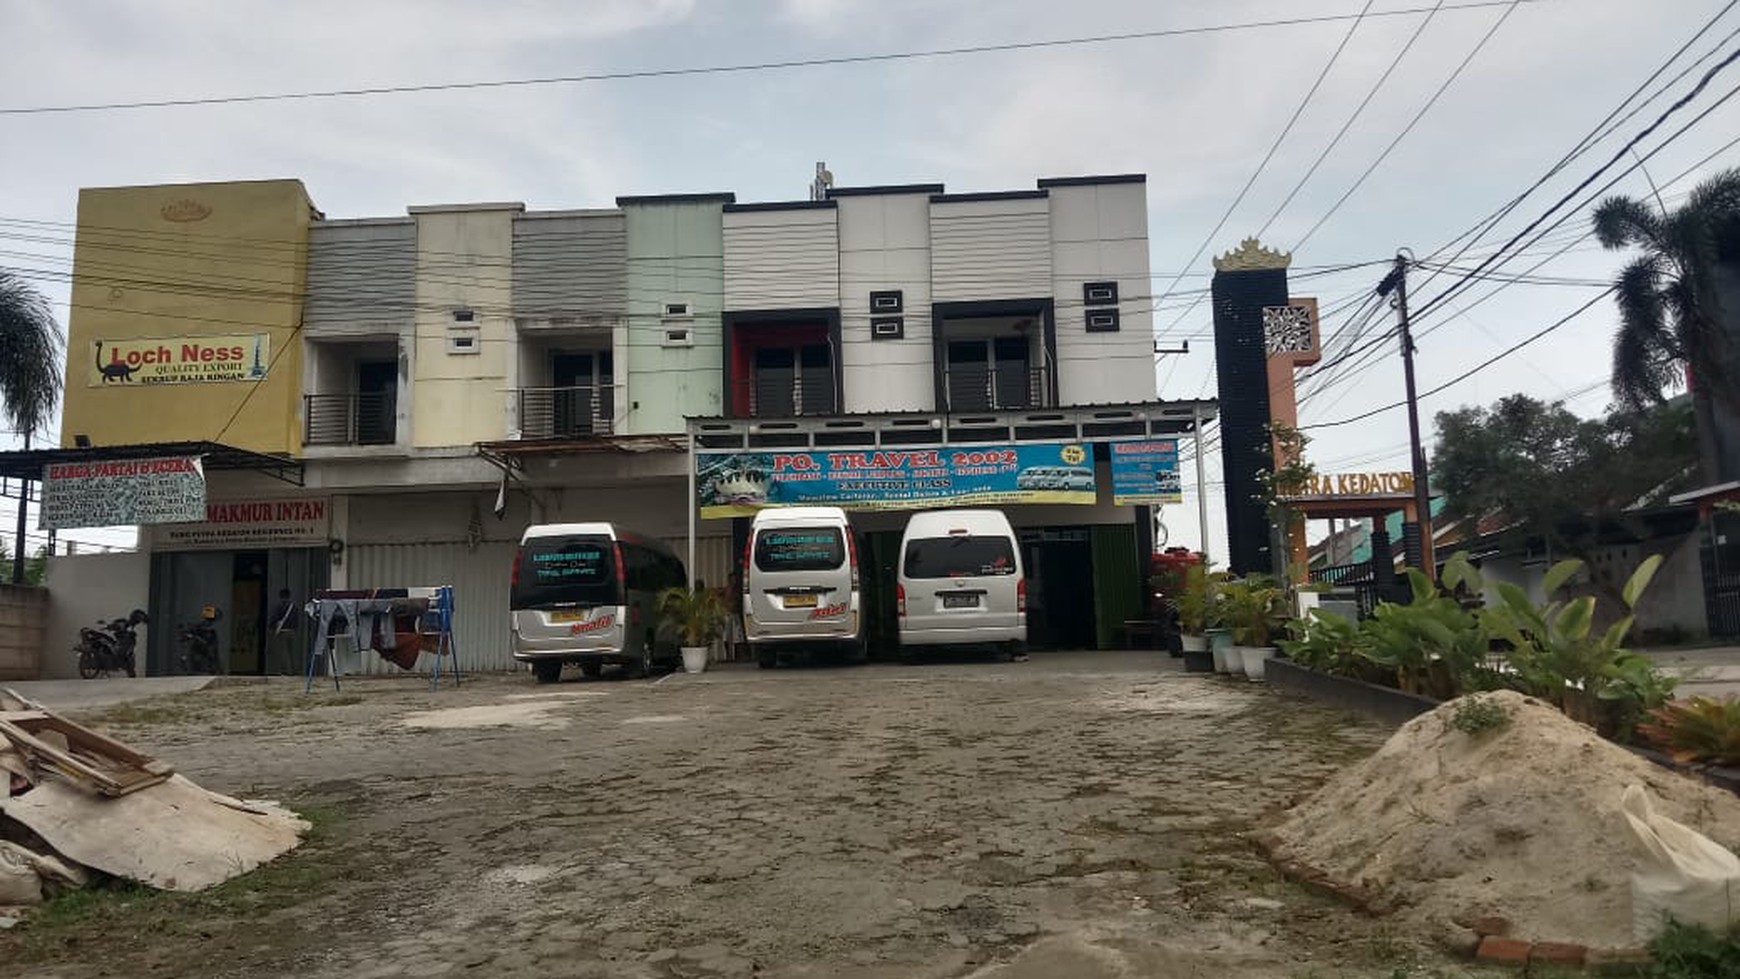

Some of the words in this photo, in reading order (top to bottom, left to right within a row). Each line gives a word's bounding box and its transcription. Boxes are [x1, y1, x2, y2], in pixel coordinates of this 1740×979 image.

[112, 346, 171, 365] Loch
[181, 345, 244, 362] Ness
[155, 364, 201, 375] QUALITY
[203, 363, 242, 373] EXPORT
[773, 453, 820, 471] PO.
[828, 450, 945, 470] TRAVEL
[952, 450, 1017, 465] 2002
[912, 479, 951, 489] CLASS
[207, 503, 273, 523] MAKMUR
[277, 501, 324, 521] INTAN
